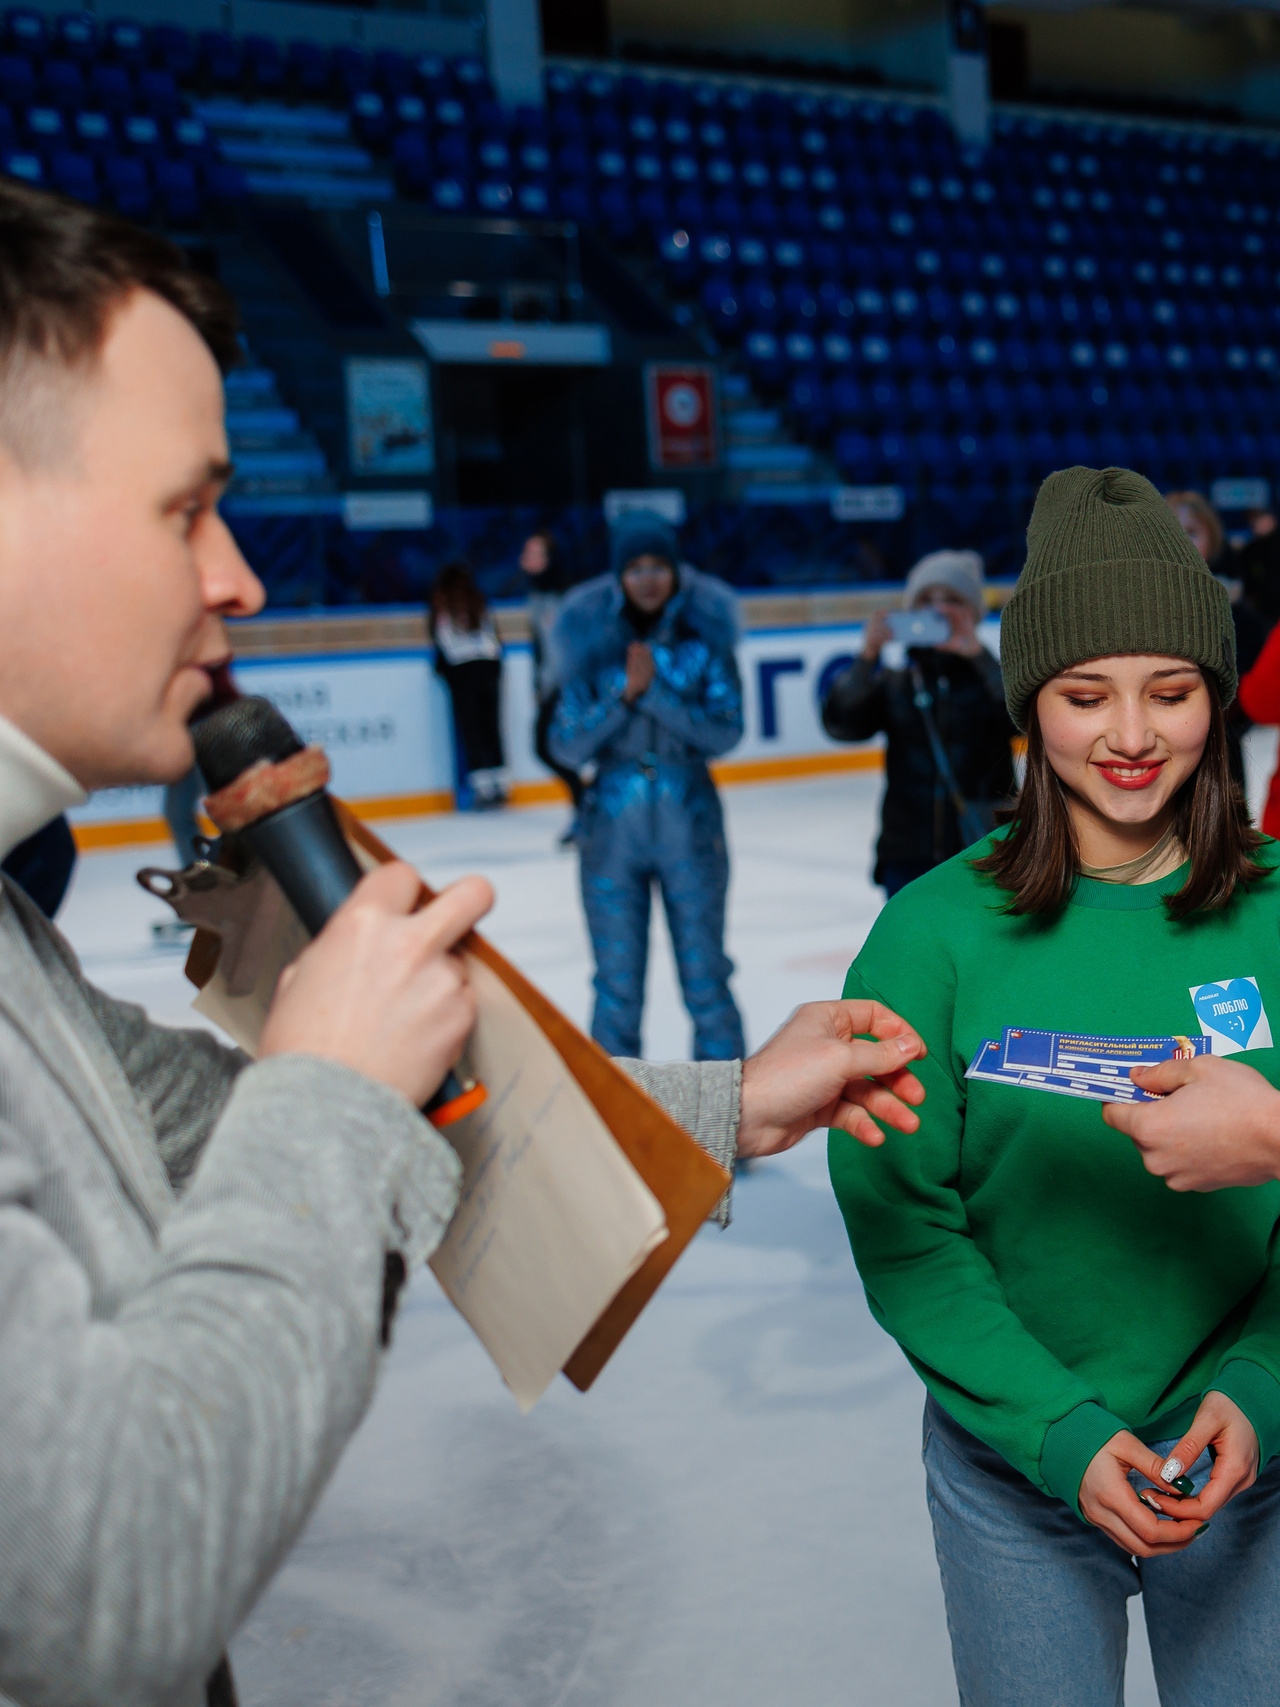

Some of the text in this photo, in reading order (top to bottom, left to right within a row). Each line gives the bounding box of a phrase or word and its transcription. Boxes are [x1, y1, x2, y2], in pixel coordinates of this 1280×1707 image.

[1212, 998, 1249, 1017] ЛЮБЛЮ
[1059, 1038, 1137, 1049] ПРИГЛАСИТЕЛЬНЫЙ
[1064, 1045, 1105, 1054] КИНОТЕАТР
